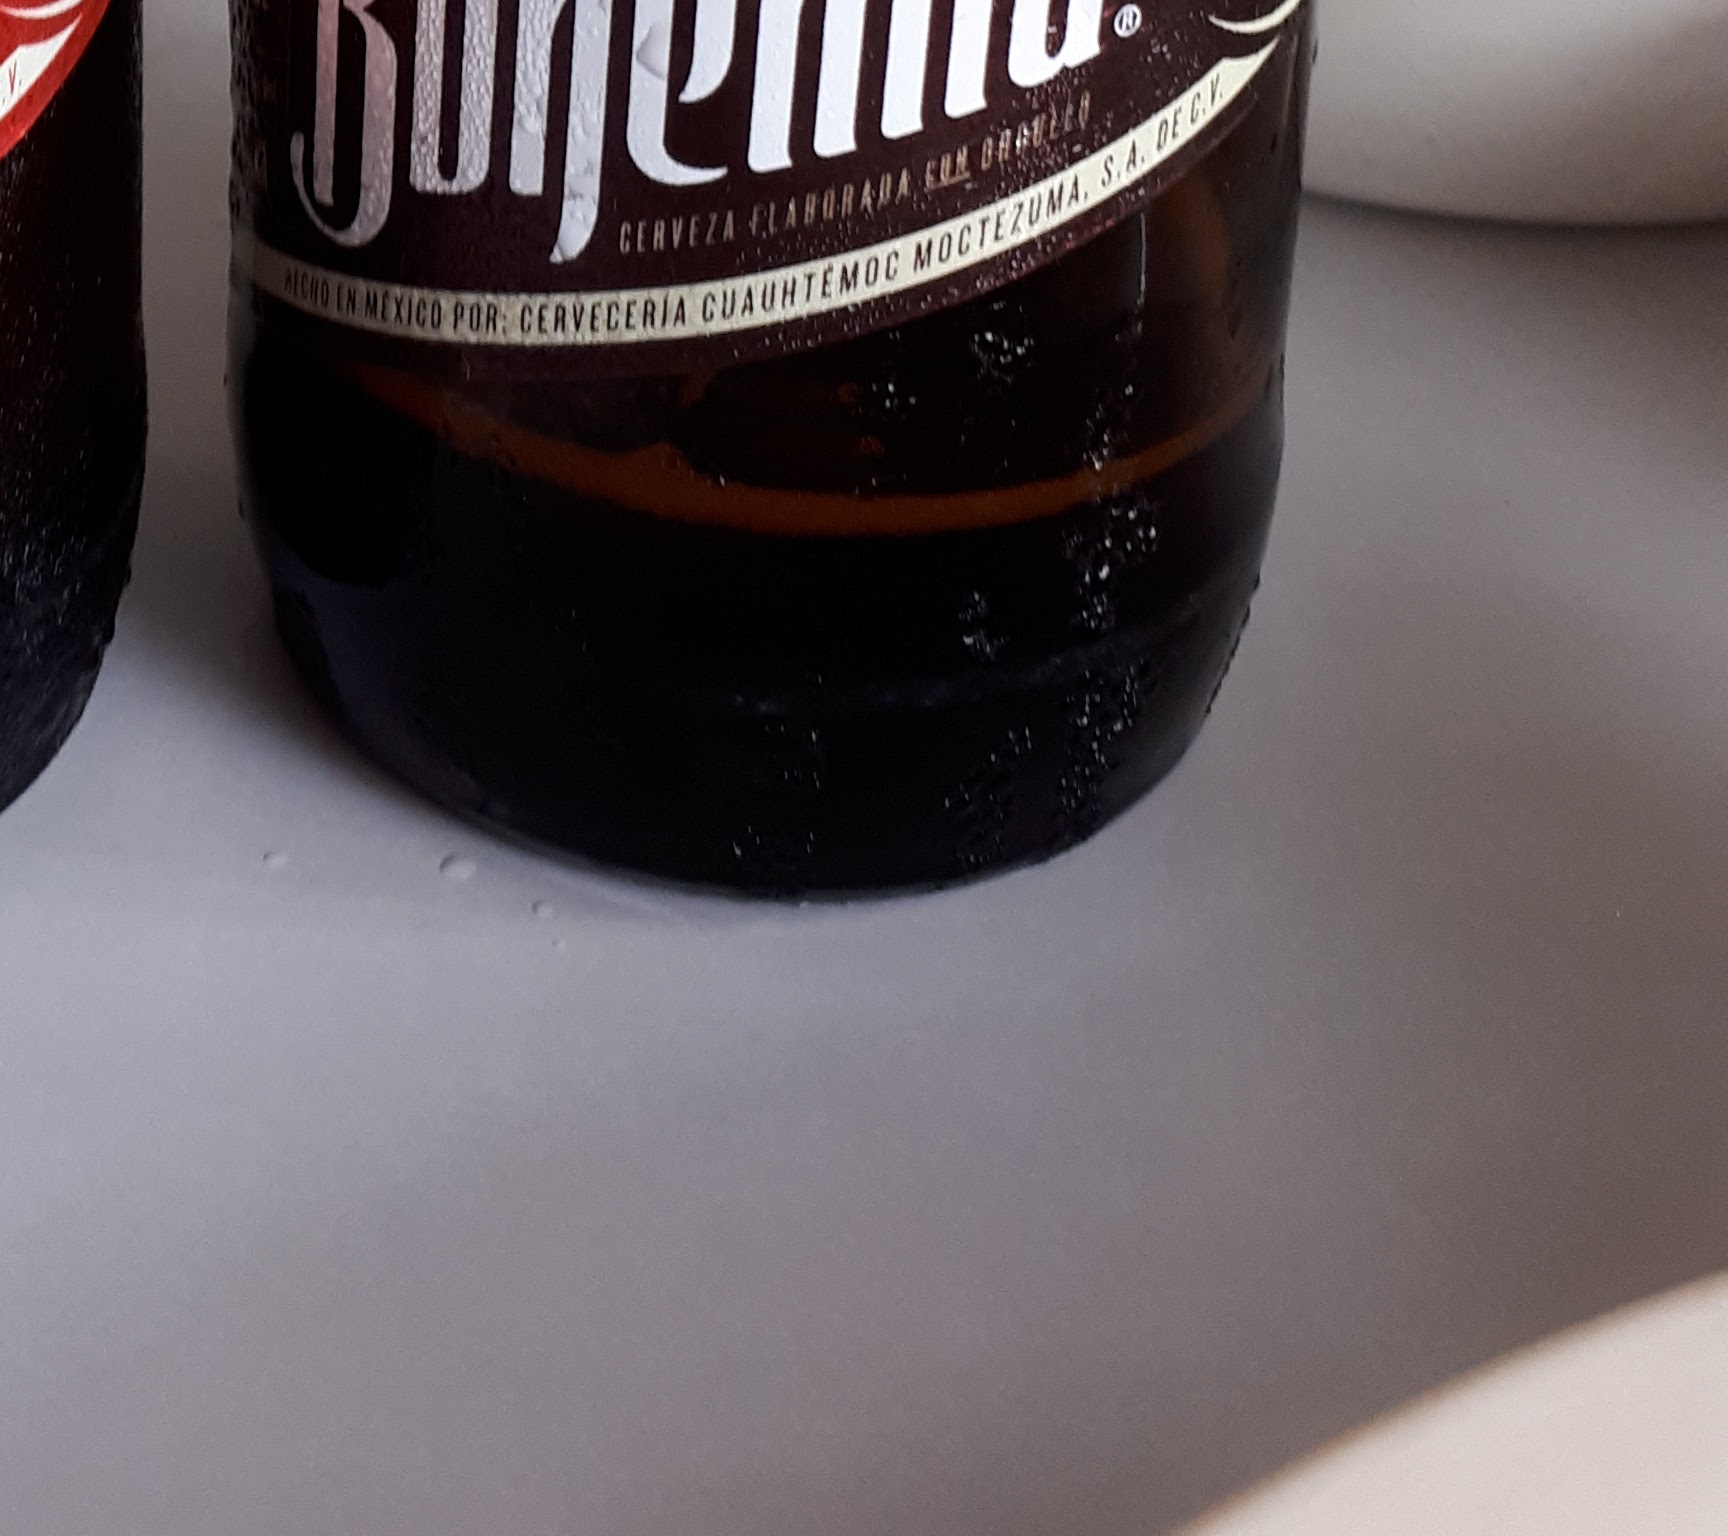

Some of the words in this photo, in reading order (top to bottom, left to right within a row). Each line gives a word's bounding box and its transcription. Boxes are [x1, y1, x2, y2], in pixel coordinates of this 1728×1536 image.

[335, 281, 358, 316] EN
[364, 285, 443, 331] MÉXICO
[452, 302, 508, 335] POR:
[519, 292, 687, 335] CERVECERÍA
[701, 249, 900, 324] CUAUHTÉMOC
[912, 174, 1090, 275] MOCTEZUMA,
[1100, 137, 1146, 189] S.A.
[1155, 109, 1183, 153] DE
[1188, 72, 1224, 126] C.V.
[618, 209, 735, 254] CERVEZA
[749, 166, 911, 237] ELABORADA
